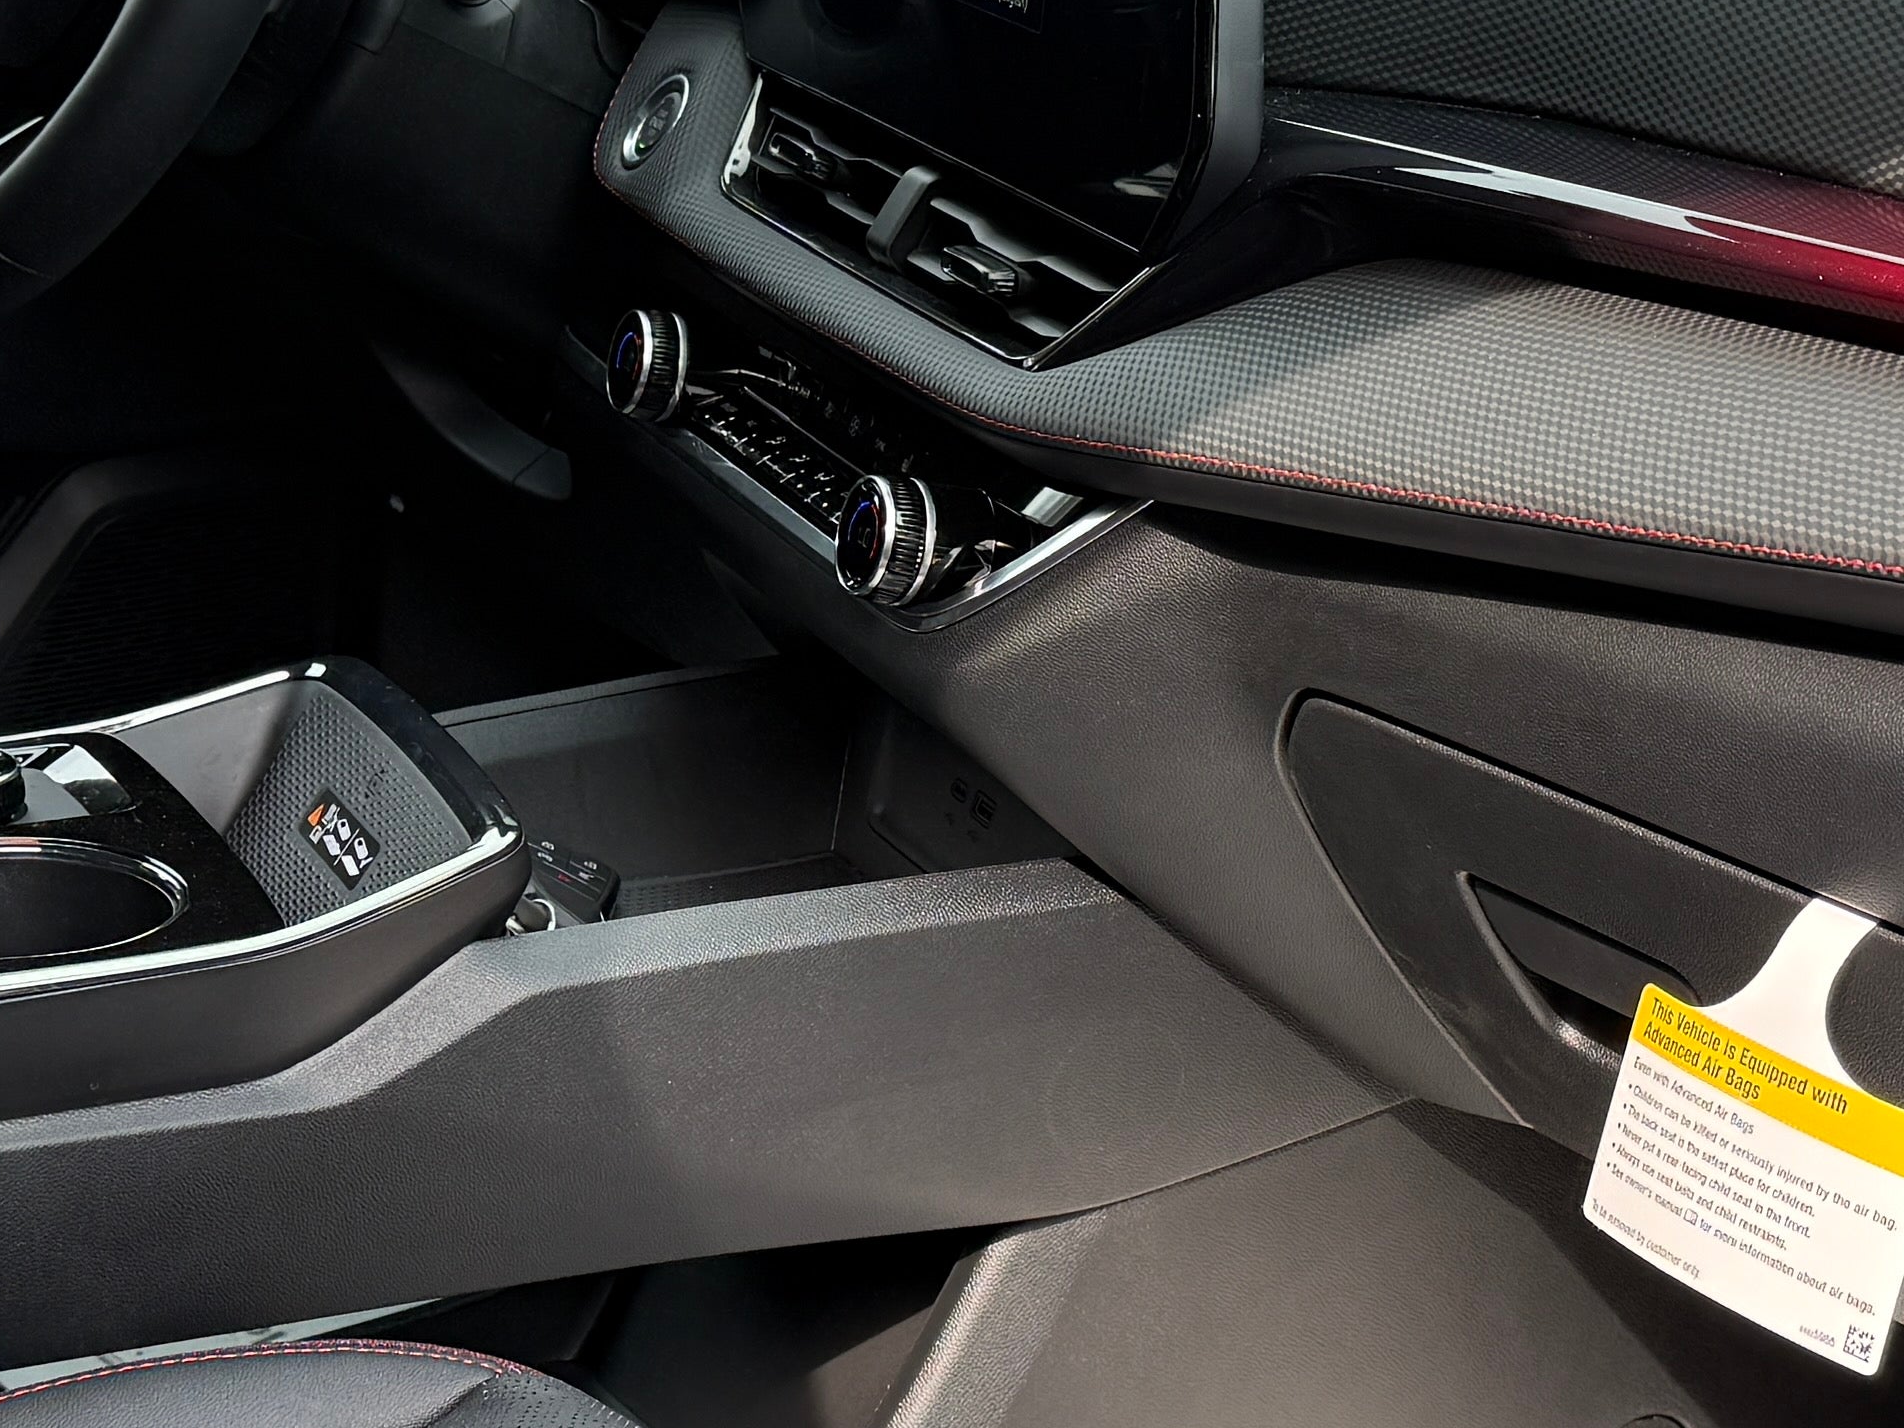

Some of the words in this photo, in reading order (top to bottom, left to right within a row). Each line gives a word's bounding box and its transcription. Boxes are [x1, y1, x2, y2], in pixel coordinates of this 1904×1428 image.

[1643, 1021, 1701, 1067] Advanced
[1700, 1055, 1723, 1078] Air
[1724, 1066, 1760, 1099] Bags
[1651, 996, 1674, 1025] This
[1676, 1011, 1720, 1051] Vehicle
[1739, 1047, 1808, 1095] Equipped
[1812, 1085, 1847, 1114] with
[1729, 1111, 1754, 1134] Bags
[1756, 1178, 1771, 1194] for
[1776, 1165, 1813, 1192] injured
[1815, 1184, 1830, 1201] by
[1852, 1203, 1869, 1217] air
